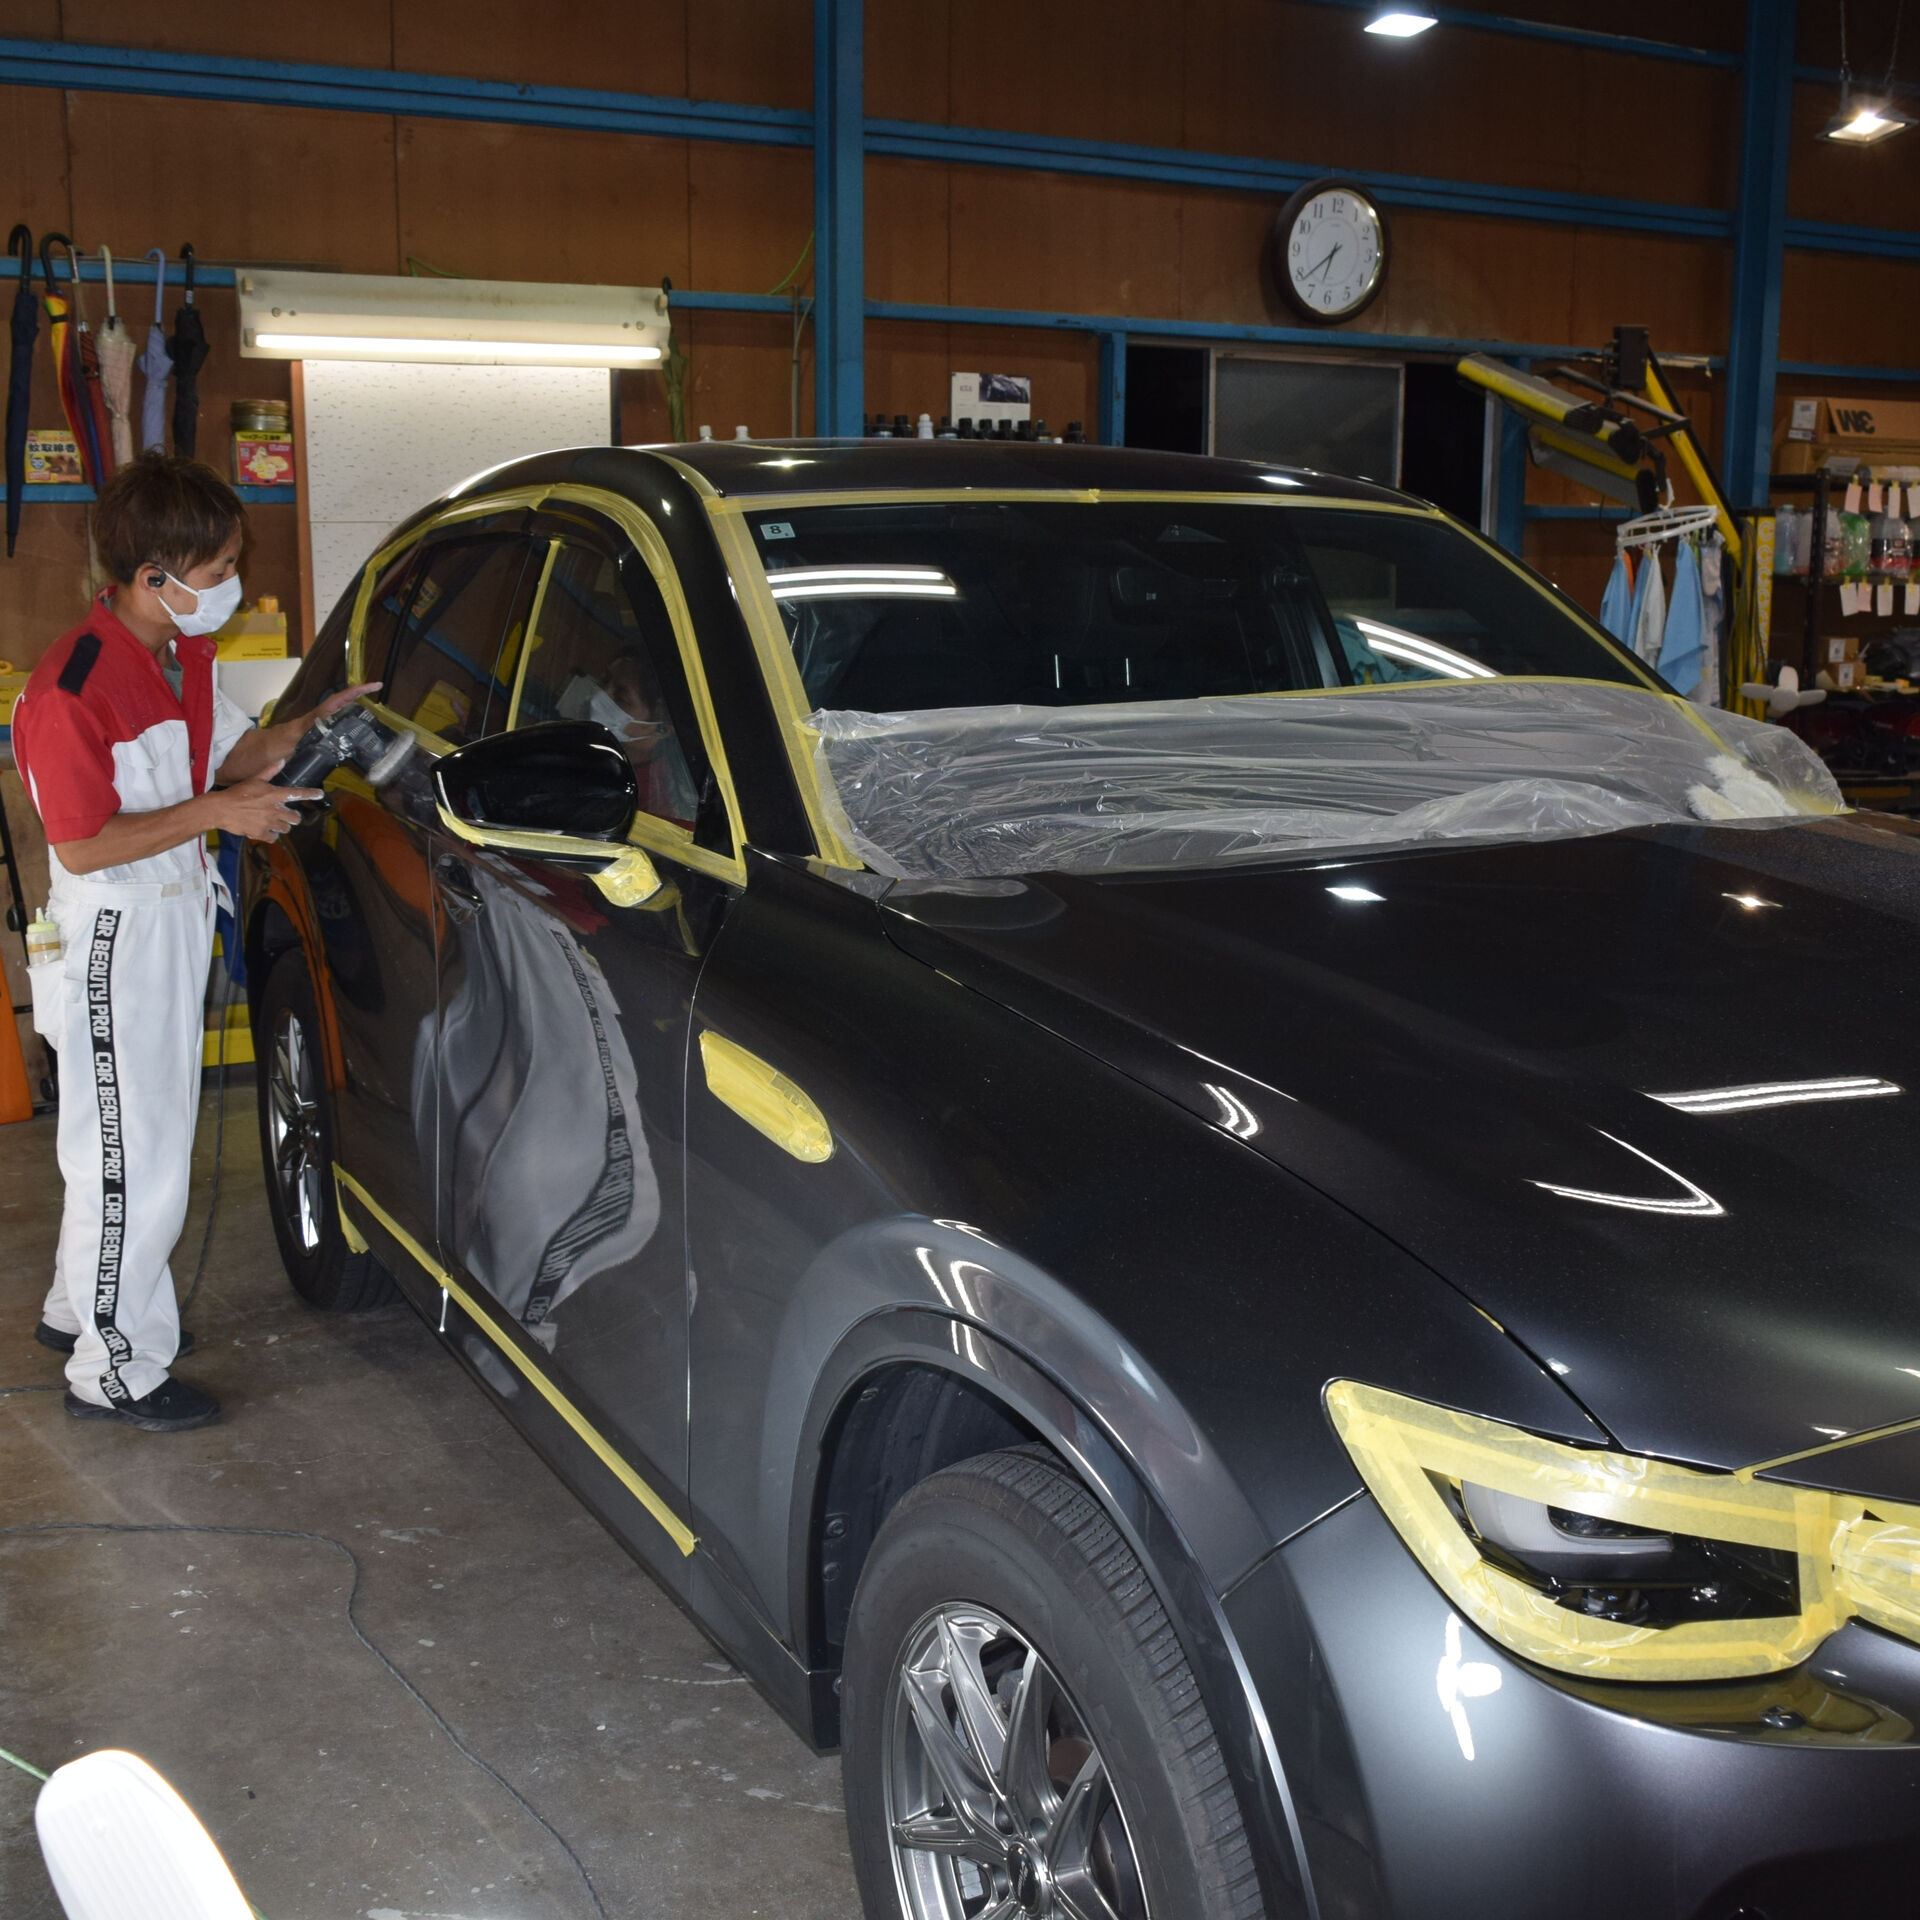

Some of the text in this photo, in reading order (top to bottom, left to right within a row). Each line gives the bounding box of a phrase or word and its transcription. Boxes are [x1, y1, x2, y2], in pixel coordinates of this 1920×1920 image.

[1313, 203, 1323, 218] 11
[1332, 198, 1344, 214] 12
[1299, 220, 1311, 235] 10
[1362, 226, 1370, 240] 2
[1292, 242, 1301, 257] 9
[1364, 250, 1372, 264] 3
[1295, 266, 1304, 282] 8
[1357, 272, 1364, 287] 4
[1308, 284, 1316, 298] 7
[1323, 289, 1332, 305] 6
[1342, 286, 1351, 301] 5
[770, 525, 782, 534] 8
[89, 938, 111, 1002] BEAUTY
[95, 1051, 115, 1084] CAR
[98, 1086, 120, 1146] BEAUTY
[105, 1192, 122, 1224] CAR
[99, 1226, 122, 1282] BEAUTY
[100, 1326, 127, 1354] CAR
